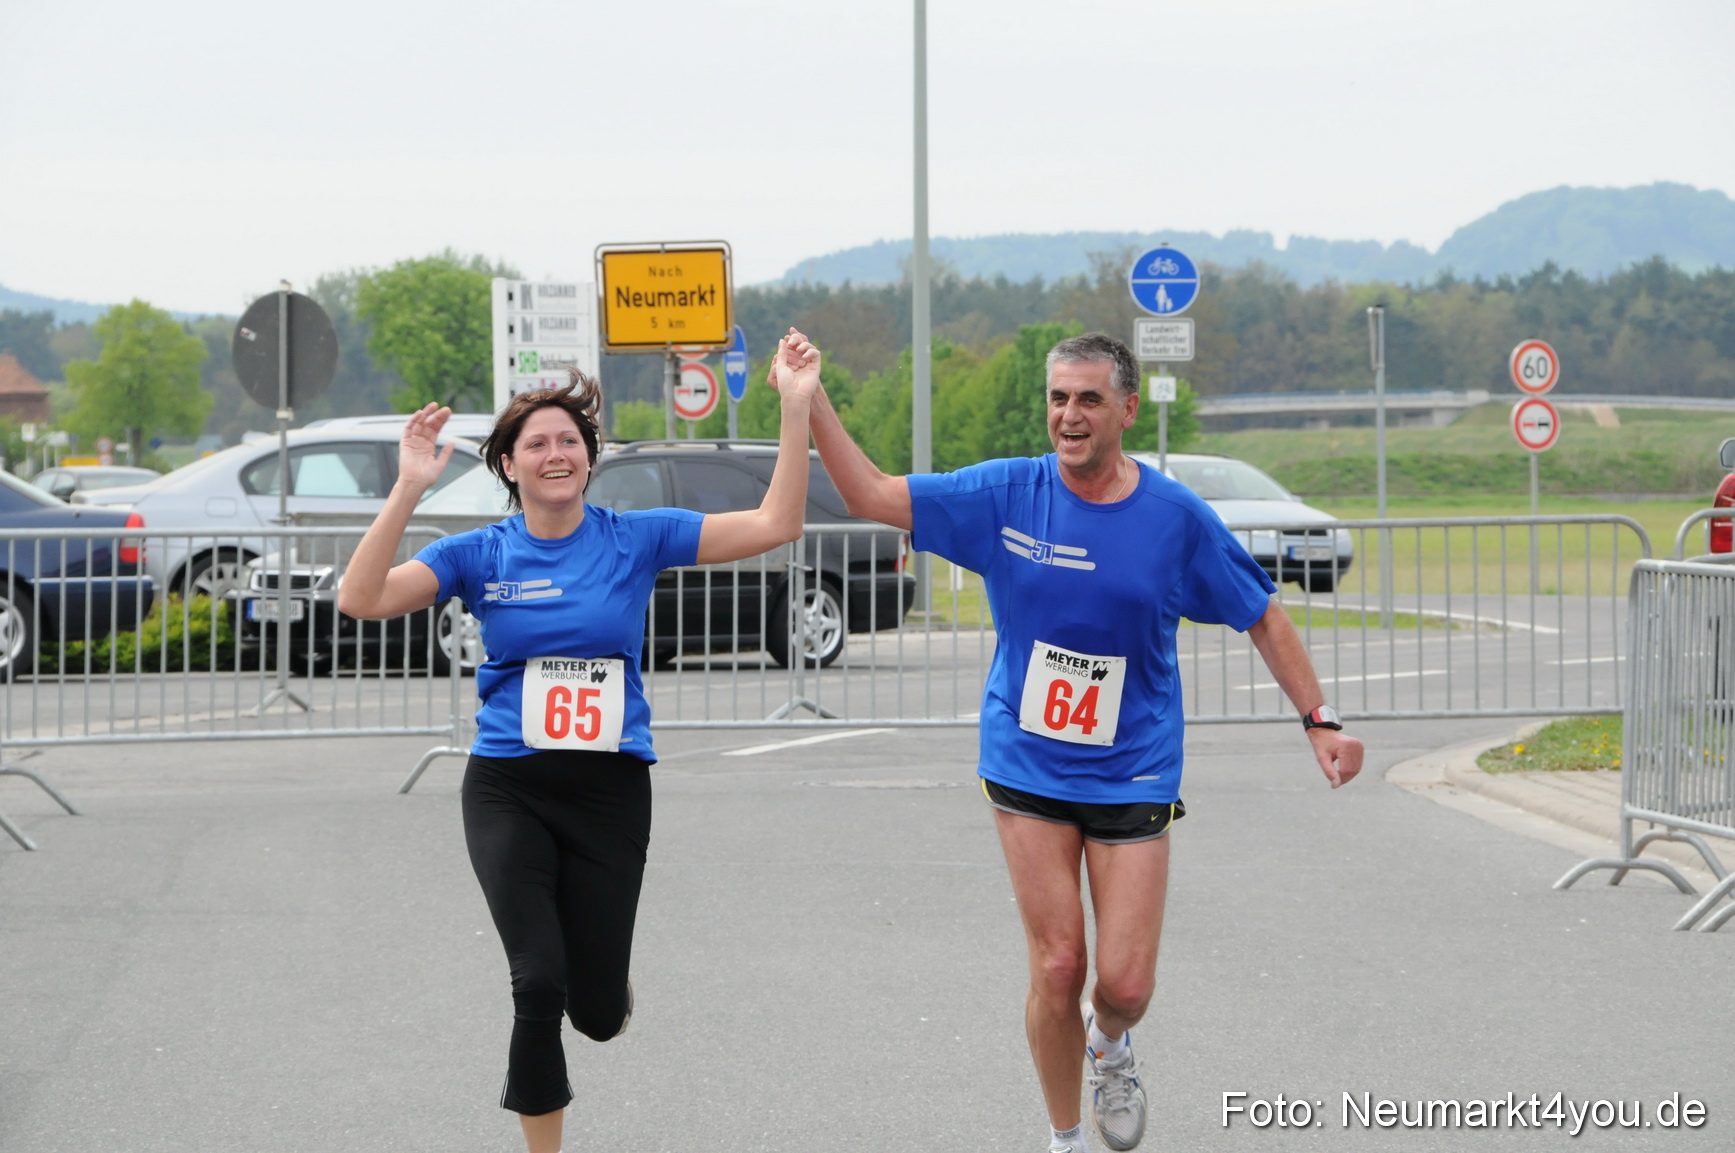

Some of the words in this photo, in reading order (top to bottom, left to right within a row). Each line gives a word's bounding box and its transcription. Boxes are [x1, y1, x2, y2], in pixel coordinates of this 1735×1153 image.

[648, 266, 683, 277] Nach
[616, 284, 716, 308] Neumarkt
[650, 317, 658, 329] 5
[668, 318, 686, 329] km
[1524, 356, 1547, 379] 60
[541, 661, 587, 672] MEYER
[1044, 660, 1089, 678] WERBUNG
[1046, 649, 1090, 670] MEYER
[541, 671, 588, 680] WERBUNG
[544, 685, 601, 742] 65
[1043, 678, 1100, 735] 64
